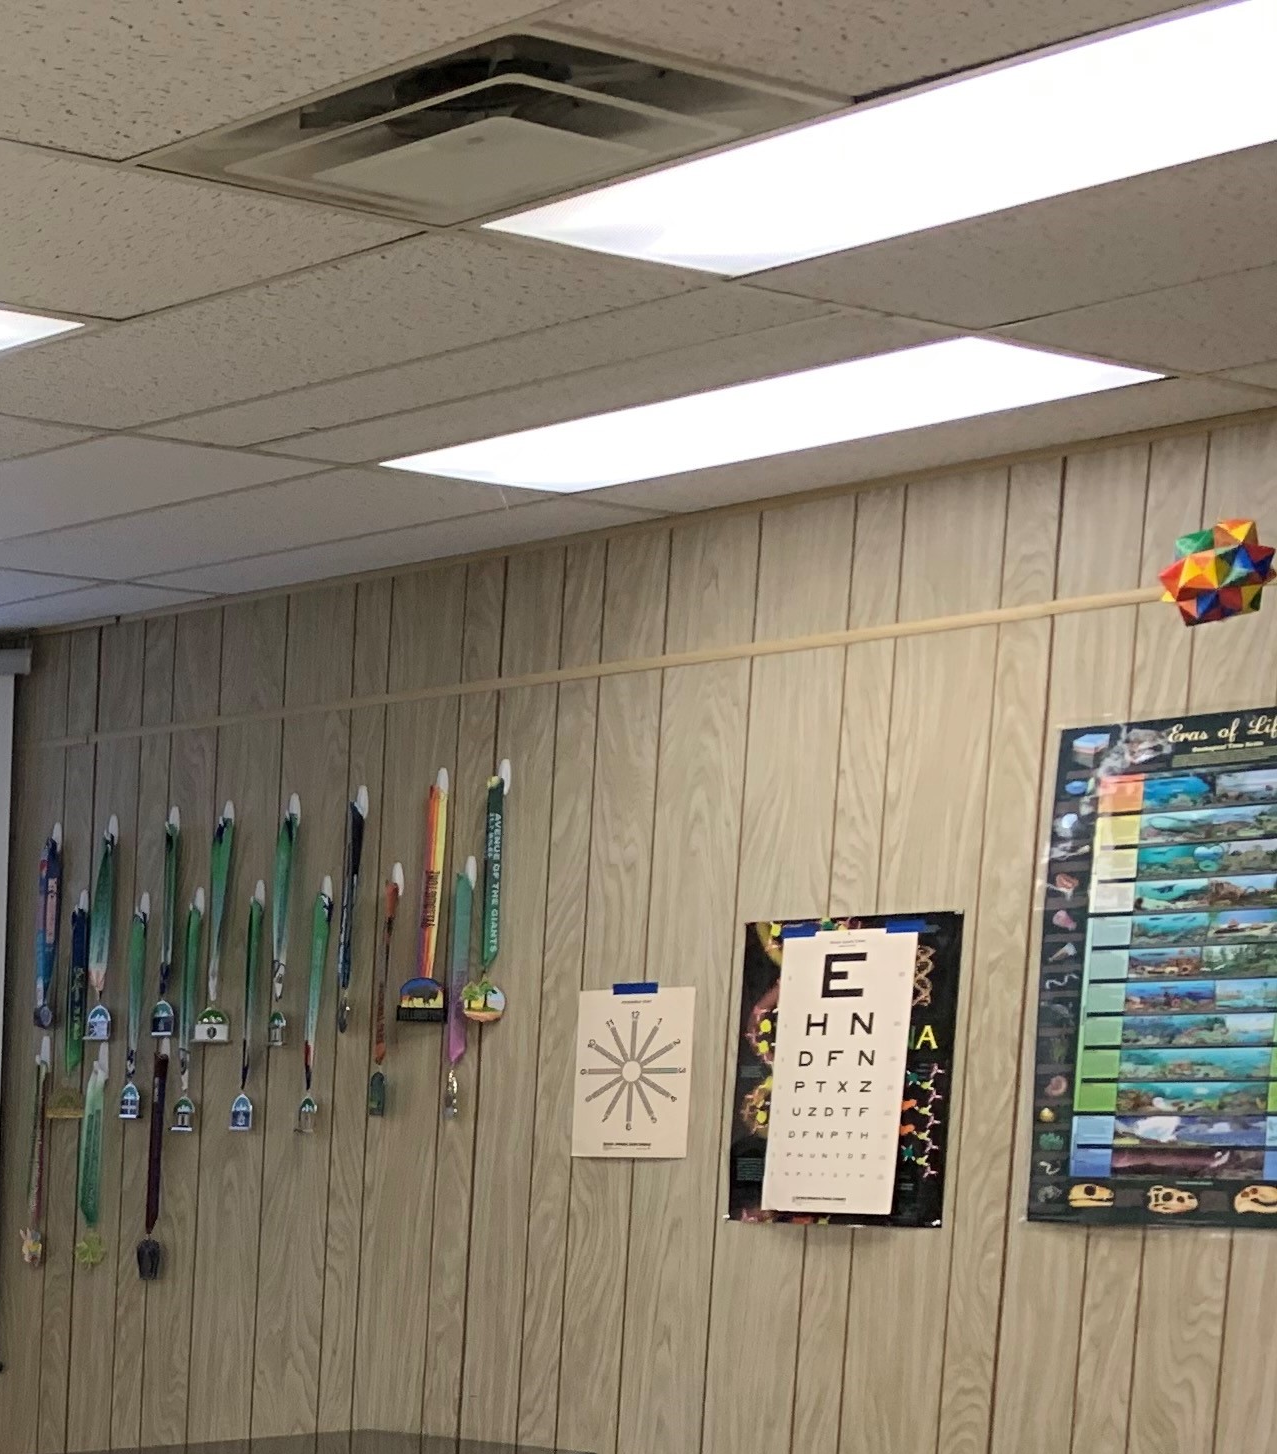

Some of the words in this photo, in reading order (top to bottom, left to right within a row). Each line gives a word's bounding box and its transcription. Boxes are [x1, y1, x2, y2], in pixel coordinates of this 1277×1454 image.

[1167, 723, 1208, 743] Eras
[1217, 717, 1240, 743] of
[493, 812, 502, 860] AVENUE
[492, 863, 501, 879] OF
[492, 882, 500, 905] THE
[490, 908, 499, 953] GIANTS
[821, 952, 868, 998] E
